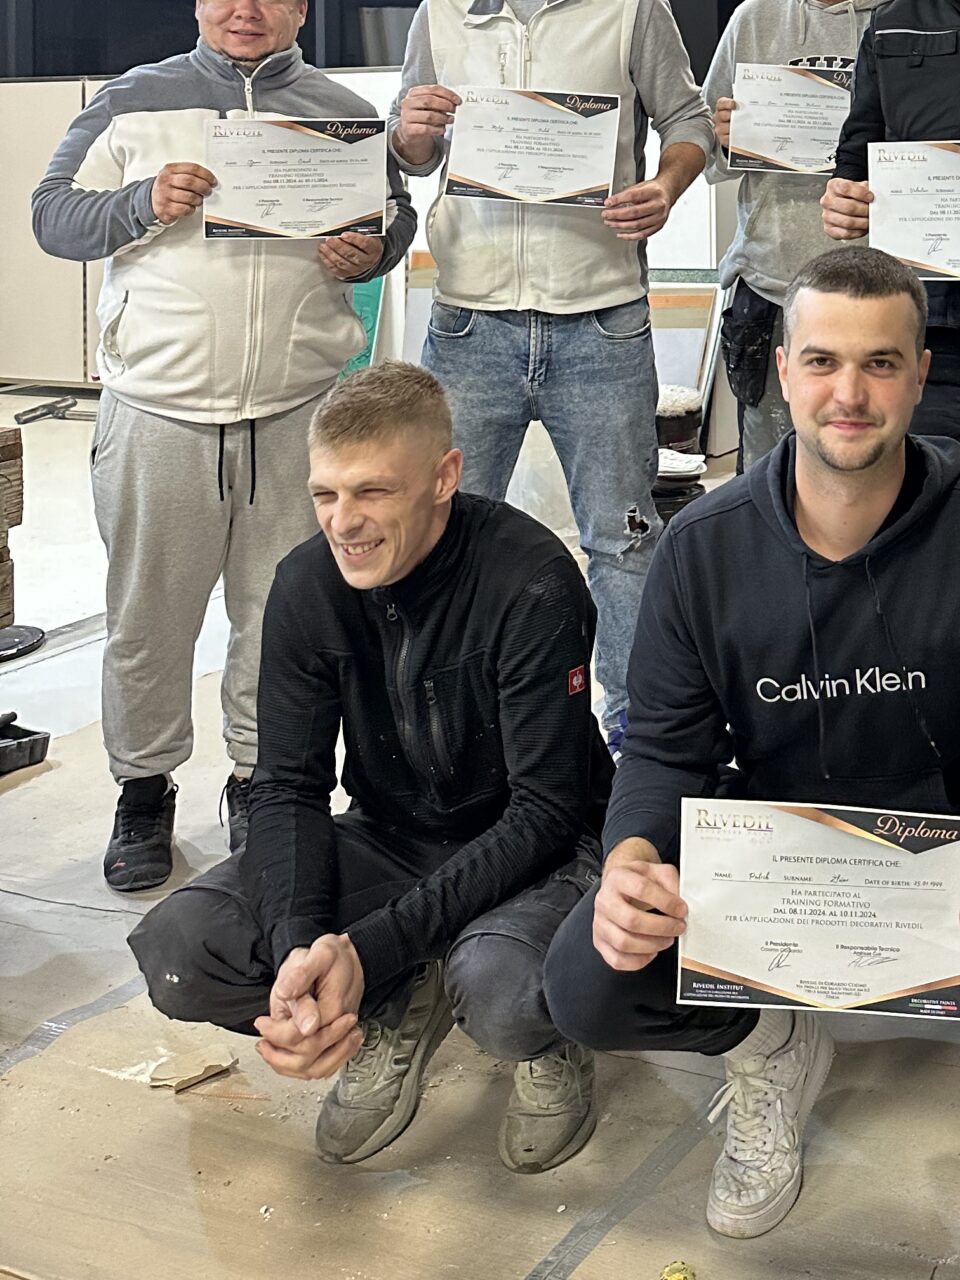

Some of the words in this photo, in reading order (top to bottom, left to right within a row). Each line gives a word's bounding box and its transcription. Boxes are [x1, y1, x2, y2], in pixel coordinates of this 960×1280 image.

[565, 95, 612, 114] Diploma
[325, 121, 378, 138] Diploma
[756, 673, 850, 703] Calvin
[696, 808, 773, 830] RIVEDIL
[873, 814, 959, 843] Diploma
[772, 854, 779, 862] IL
[780, 855, 814, 864] PRESENTE
[815, 857, 847, 866] DIPLOMA
[848, 859, 884, 868] CERTIFICA
[791, 888, 803, 896] HA
[804, 889, 852, 899] PARTECIPATO
[781, 898, 821, 907] TRAINING
[823, 900, 871, 908] FORMATIVO
[724, 914, 738, 922] PER
[739, 915, 795, 926] L'APPLICAZIONE
[810, 920, 848, 928] PRODOTTI
[850, 921, 893, 929] DECORATIVI
[692, 982, 715, 990] RIVEDIL
[716, 984, 743, 992] INSTITUT
